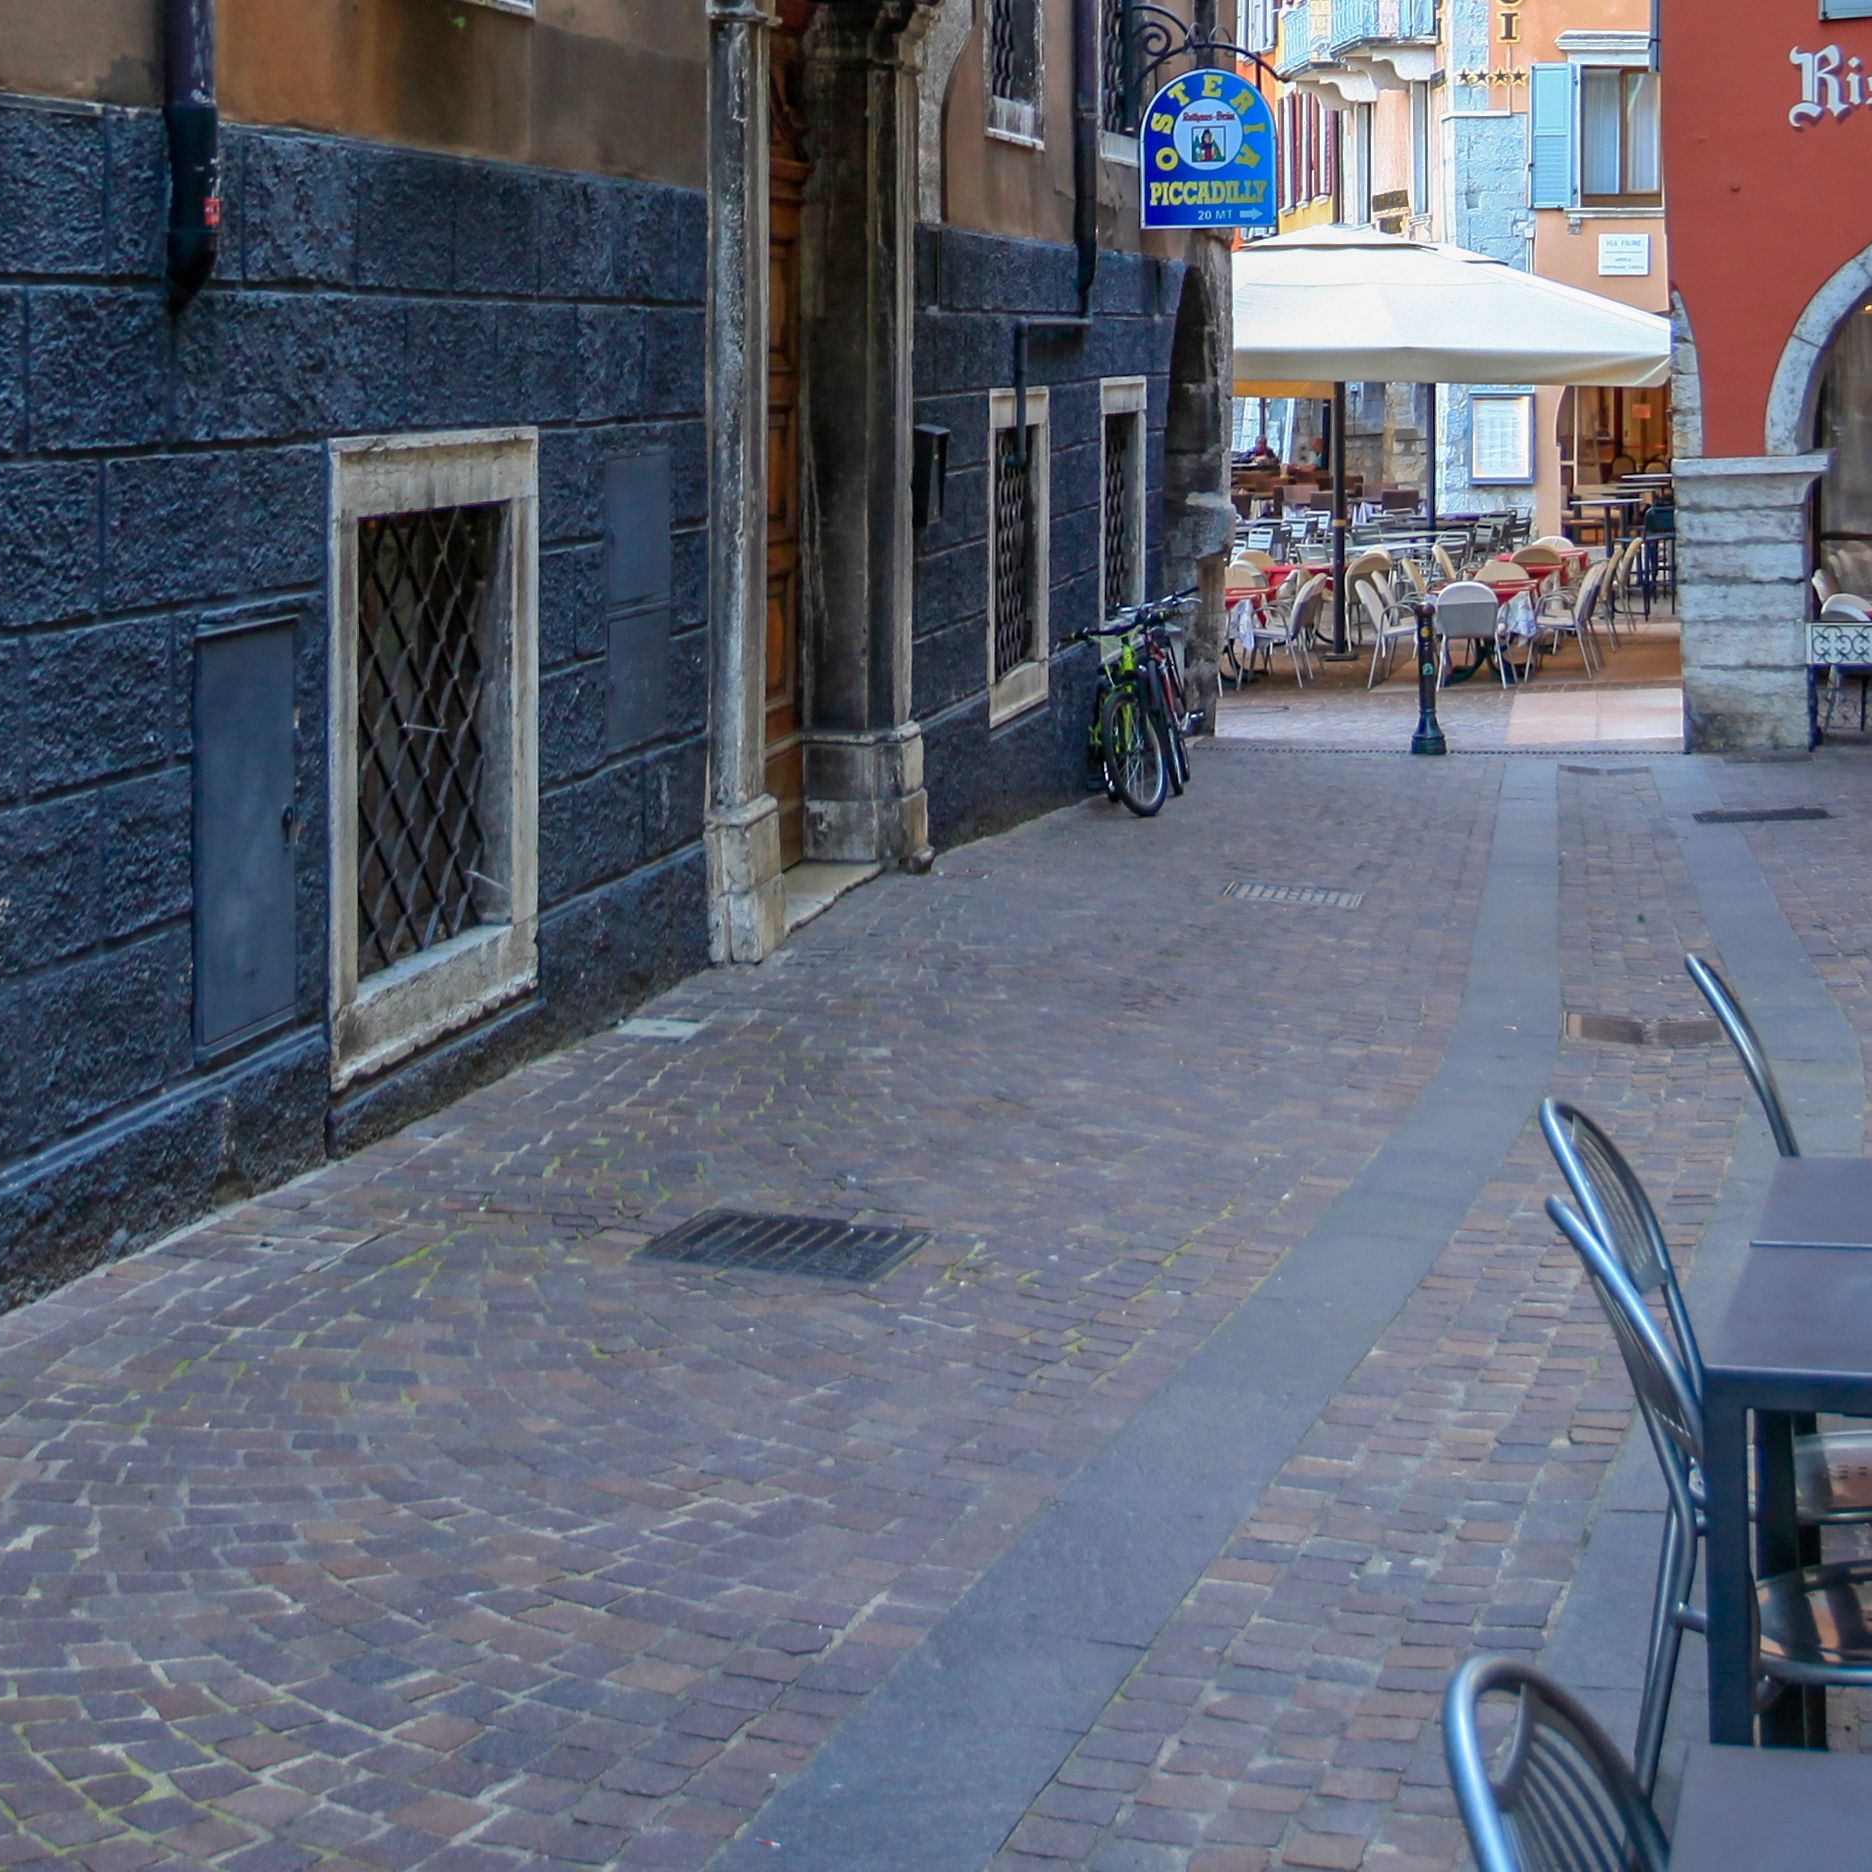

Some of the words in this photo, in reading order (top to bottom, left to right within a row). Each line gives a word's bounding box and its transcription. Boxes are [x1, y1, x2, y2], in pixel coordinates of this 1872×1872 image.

[1150, 74, 1266, 171] OSTERIA
[1149, 180, 1268, 206] PICCADILLY
[1197, 210, 1212, 221] 20
[1215, 209, 1233, 220] MT
